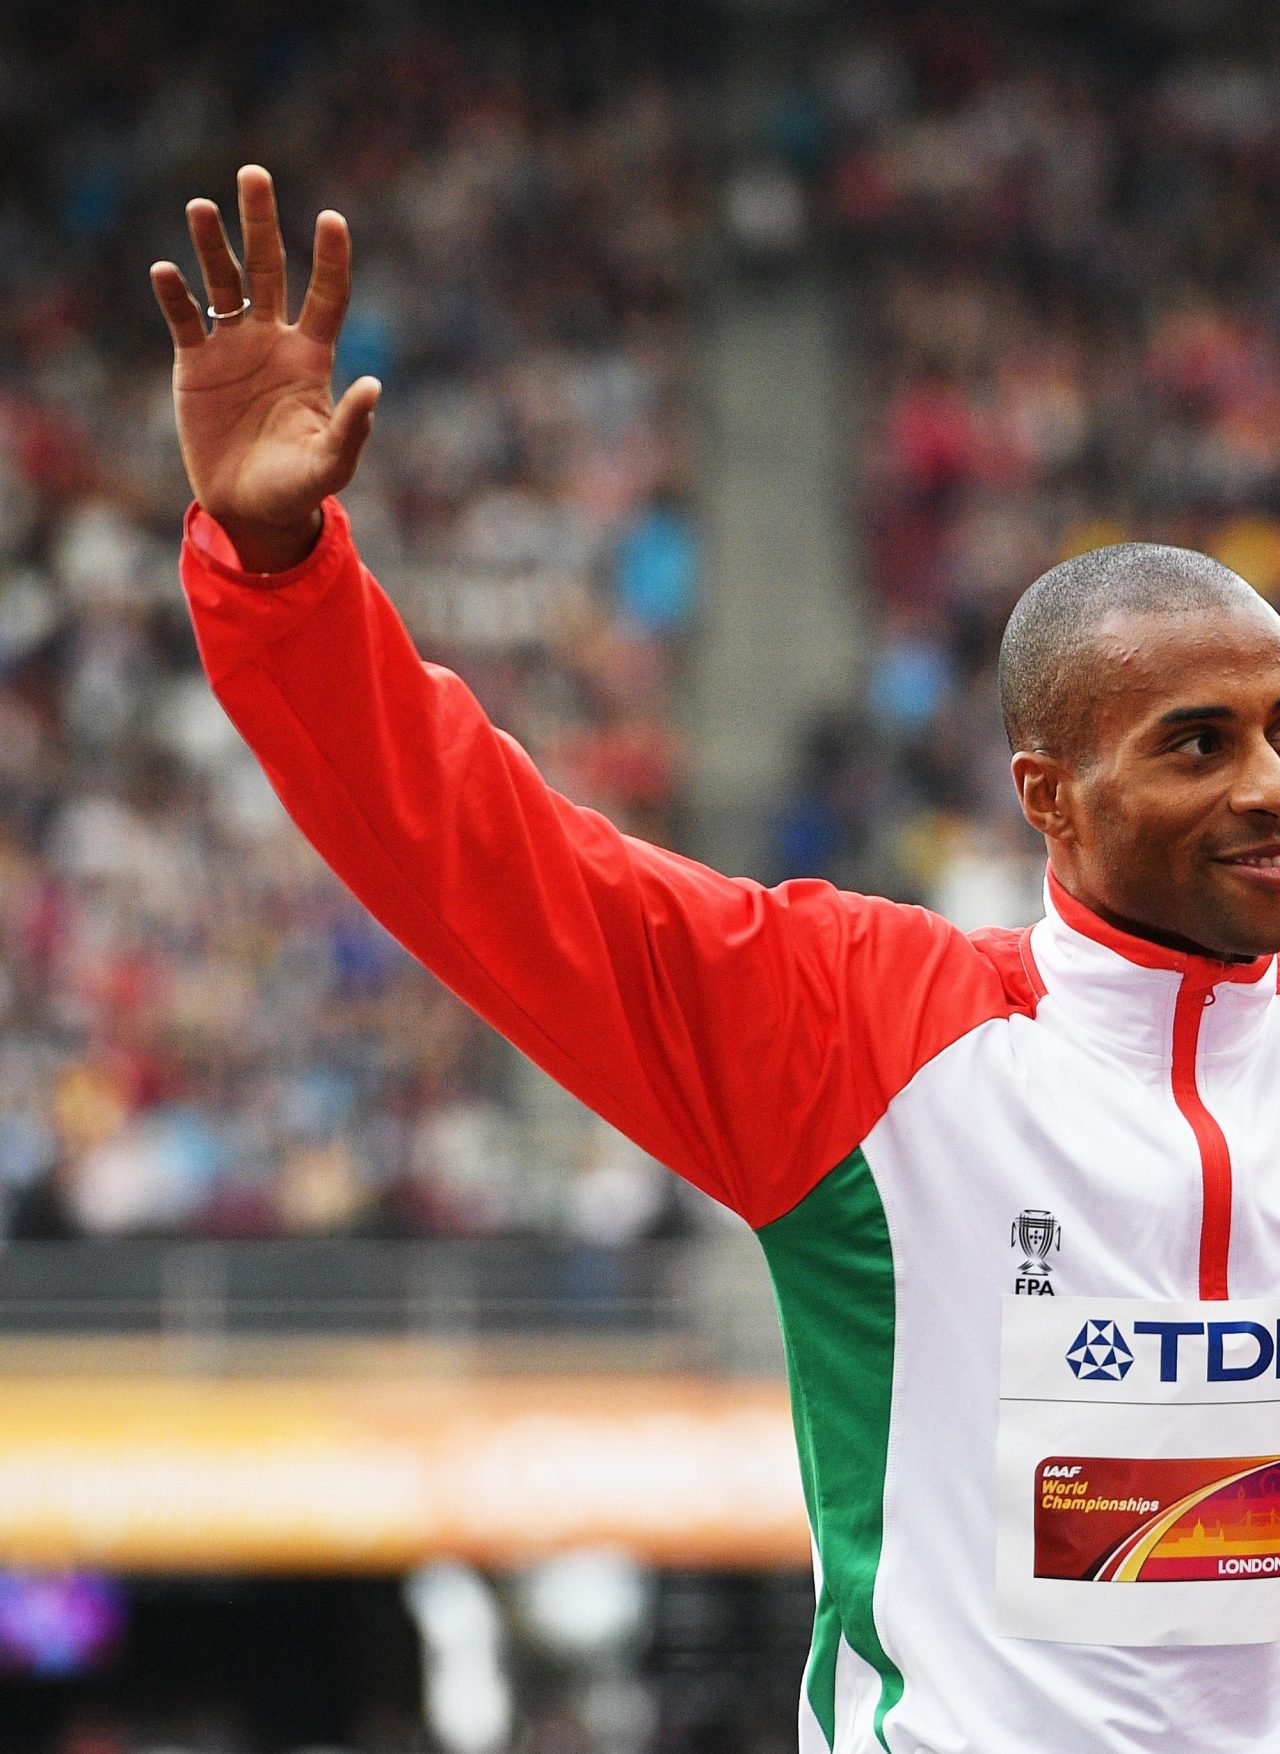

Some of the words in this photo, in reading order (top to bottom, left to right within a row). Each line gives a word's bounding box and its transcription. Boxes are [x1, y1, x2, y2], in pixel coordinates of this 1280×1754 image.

[1015, 1278, 1055, 1296] FPA
[1043, 1466, 1082, 1477] IAAF
[1042, 1480, 1088, 1494] World
[1042, 1494, 1159, 1514] Championships
